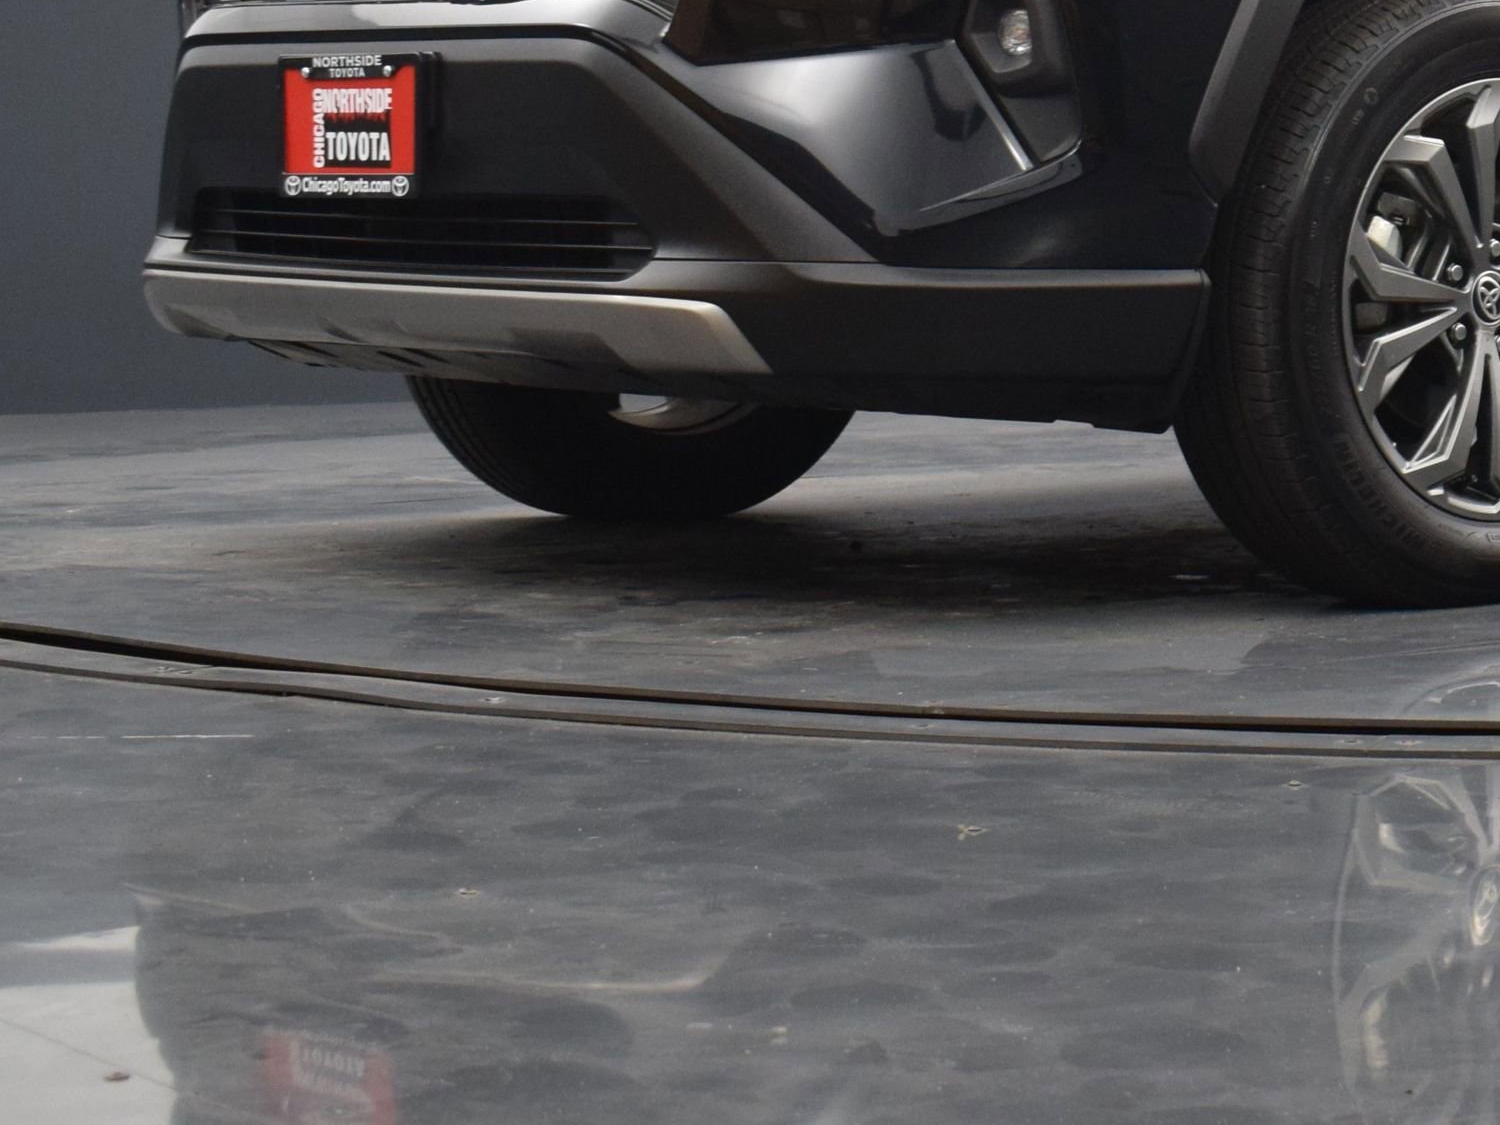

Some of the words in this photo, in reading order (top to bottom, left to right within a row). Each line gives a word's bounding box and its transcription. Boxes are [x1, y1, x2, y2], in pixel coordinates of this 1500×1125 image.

[312, 55, 382, 68] NORTHSIDE
[329, 67, 366, 78] TOYOTA
[321, 88, 393, 114] NORTHSIDE
[312, 88, 325, 168] CHICAGO
[325, 131, 391, 162] TOYOTA
[302, 177, 391, 195] ChicagoToyota.com
